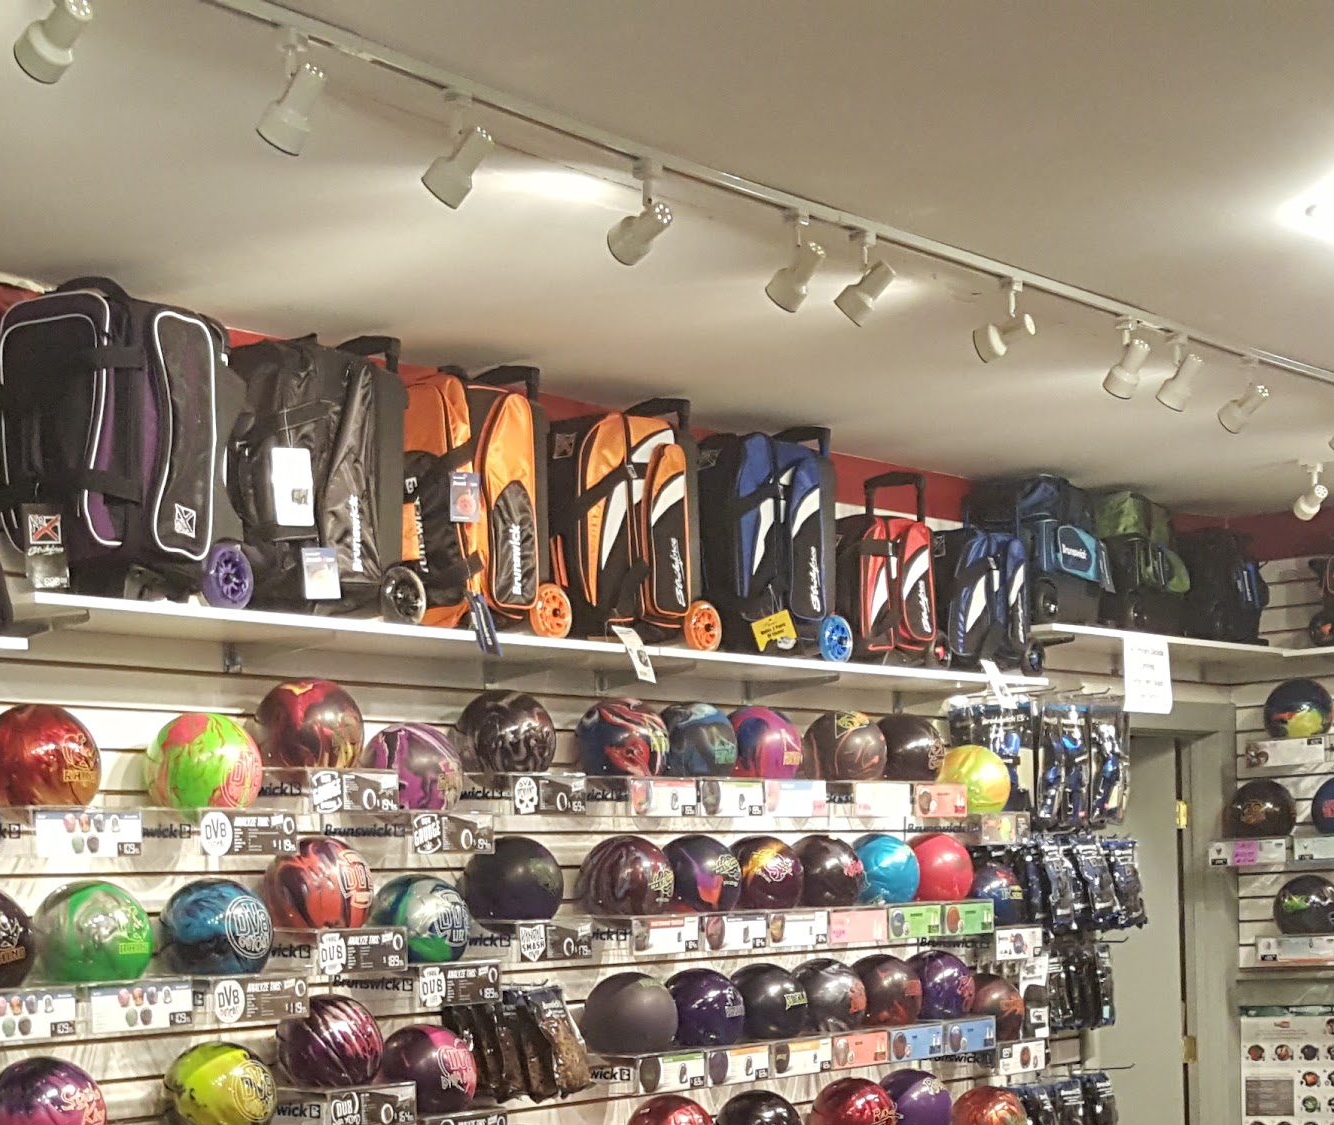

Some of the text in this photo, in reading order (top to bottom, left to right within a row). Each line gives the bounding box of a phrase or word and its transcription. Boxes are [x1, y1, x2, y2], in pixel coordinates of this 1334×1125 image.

[351, 493, 365, 573] Brunswick
[509, 523, 524, 596] Brunswick
[324, 824, 392, 838] Brunswick
